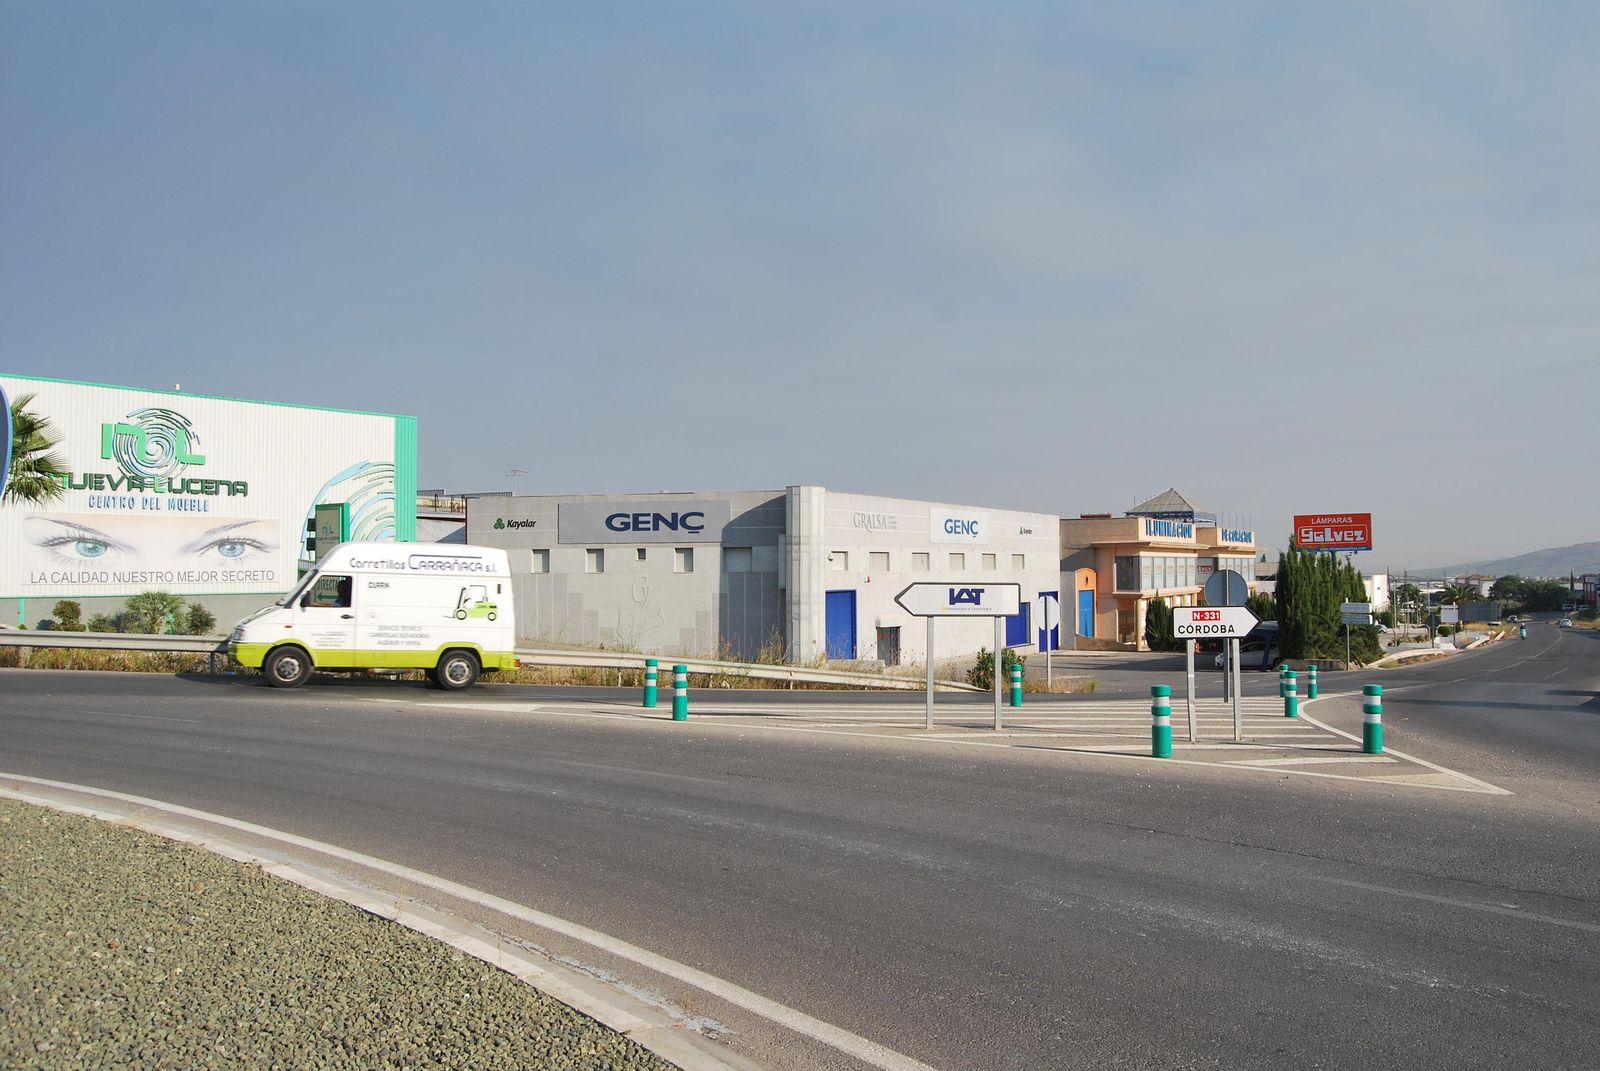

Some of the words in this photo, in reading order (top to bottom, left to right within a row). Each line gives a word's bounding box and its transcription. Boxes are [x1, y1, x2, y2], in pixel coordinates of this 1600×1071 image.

[88, 494, 136, 510] CENTRO
[142, 495, 161, 511] DEL
[168, 497, 209, 512] MUEBLE
[506, 519, 537, 530] Kayalar
[605, 511, 705, 534] GENÇ
[853, 512, 887, 533] GRALSA
[944, 518, 979, 538] GENÇ
[30, 571, 48, 584] LA
[51, 571, 109, 584] CALIDAD
[113, 570, 174, 583] NUESTRO
[177, 570, 218, 583] MEJOR
[221, 569, 275, 582] SECRETO
[1193, 611, 1220, 620] N-331
[1177, 622, 1235, 634] CÓRDOBA
